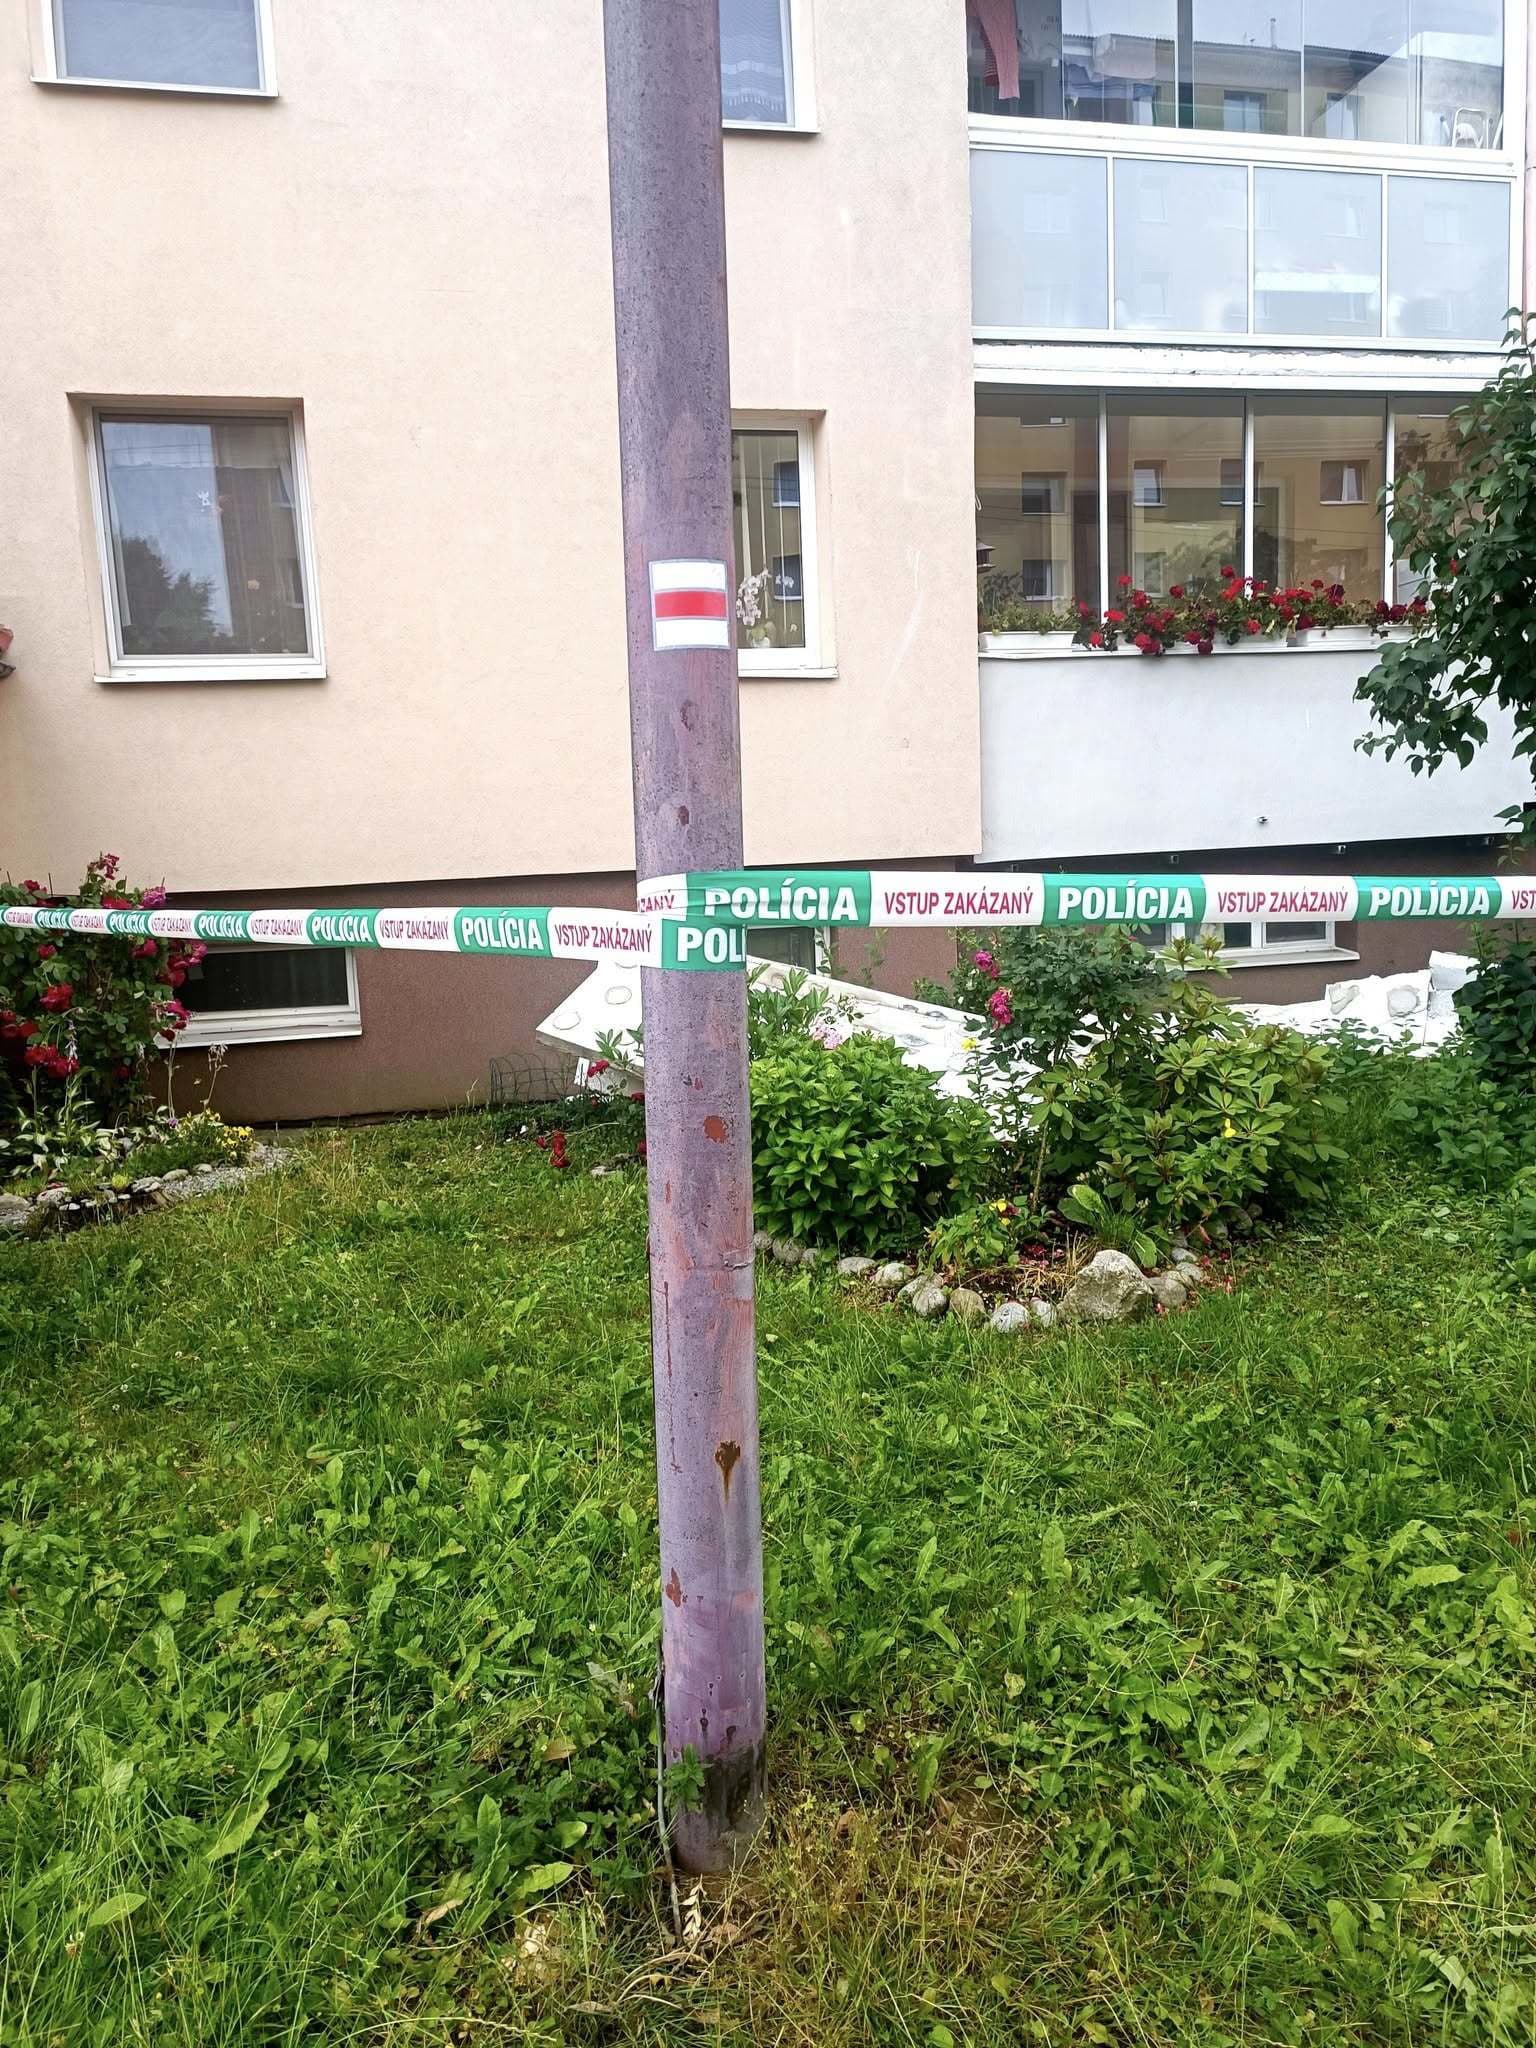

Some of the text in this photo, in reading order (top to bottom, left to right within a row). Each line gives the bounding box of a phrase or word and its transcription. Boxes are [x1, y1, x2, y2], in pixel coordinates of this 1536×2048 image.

[638, 889, 675, 913] ZANÝ
[704, 877, 859, 921] POLÍCIA
[884, 891, 939, 915] VSTUP
[943, 886, 1034, 915] ZAKÁZANÝ
[1057, 879, 1194, 920] POLÍCIA
[1217, 890, 1266, 913] VSTUP
[1268, 885, 1348, 913] ZAKÁZANÝ
[1368, 880, 1490, 917] POLÍCIA
[198, 911, 247, 938] POLÍCIA
[311, 910, 374, 943] POLÍCIA
[379, 919, 404, 940] VSTUP
[461, 910, 545, 950] POLÍCIA
[554, 924, 590, 947] VSTUP
[592, 921, 652, 953] ZAKÁZANÝ
